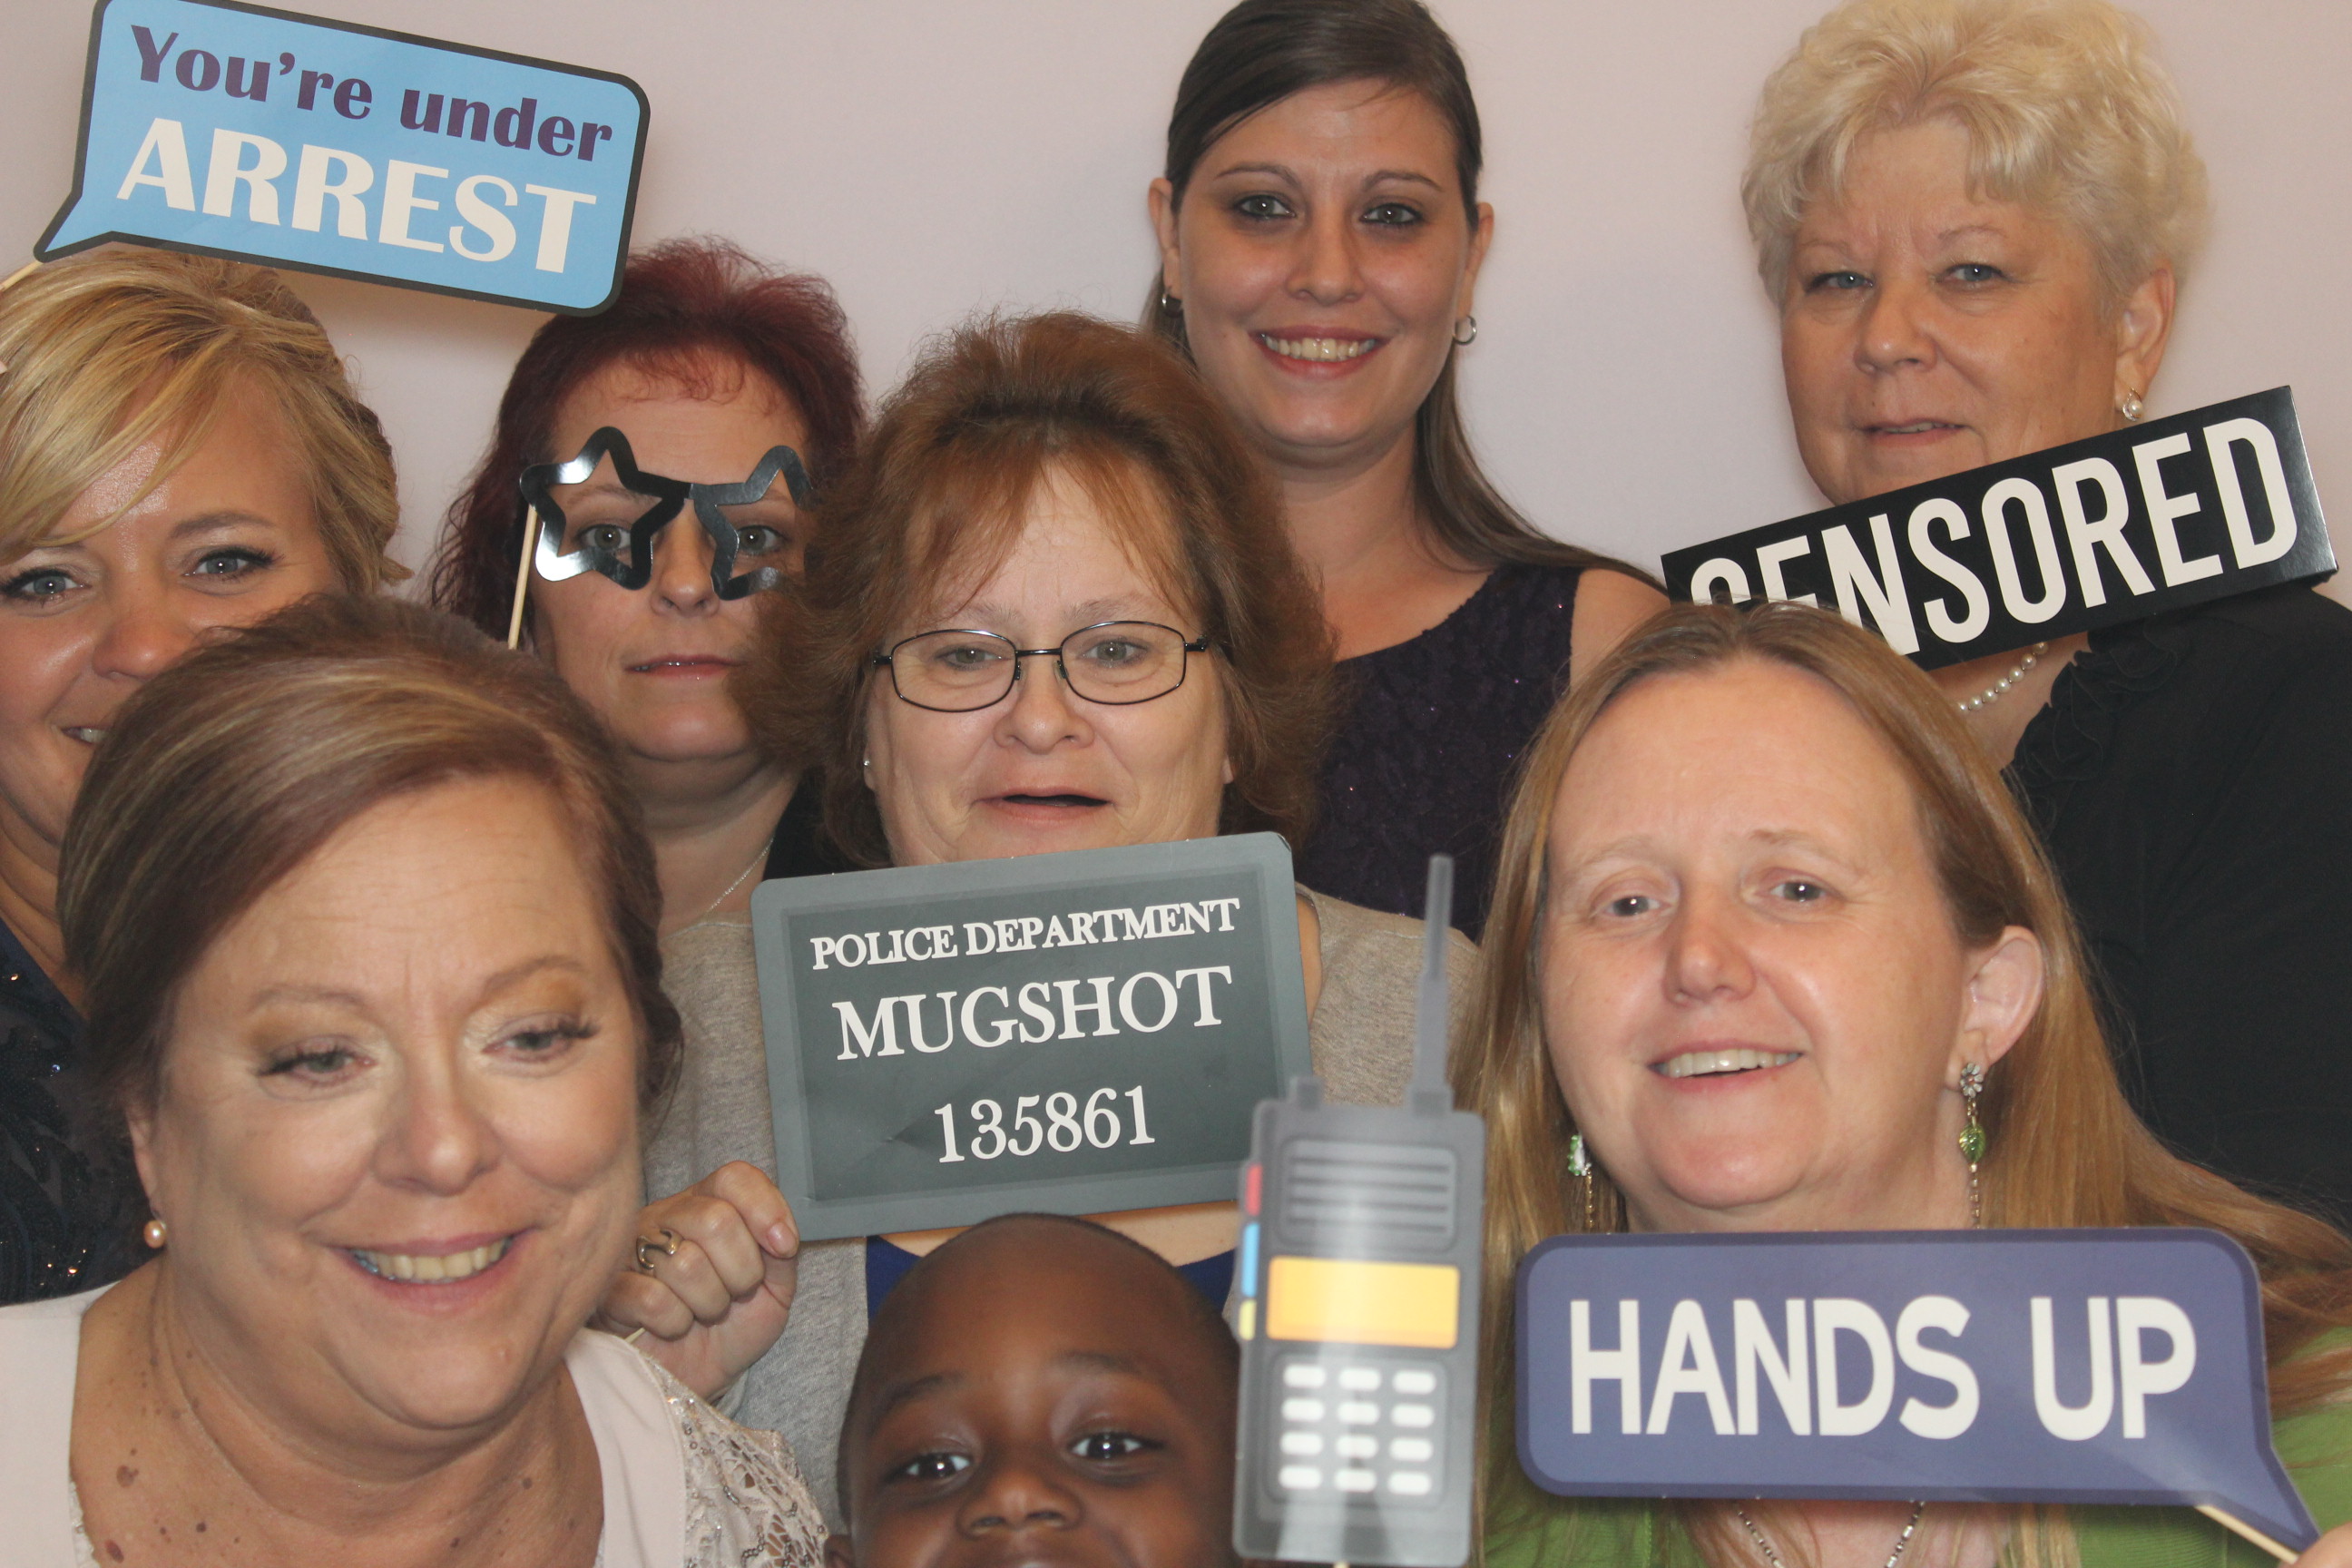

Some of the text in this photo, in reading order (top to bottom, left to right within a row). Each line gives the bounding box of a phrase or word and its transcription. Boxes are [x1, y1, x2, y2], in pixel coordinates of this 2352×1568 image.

[131, 24, 613, 162] You're under
[116, 117, 597, 274] ARREST
[809, 897, 1240, 970] POLICE DEPARTMENT
[831, 965, 1232, 1061] MUGSHOT
[934, 1084, 1155, 1163] 135861
[1570, 1295, 2197, 1441] HANDS UP
